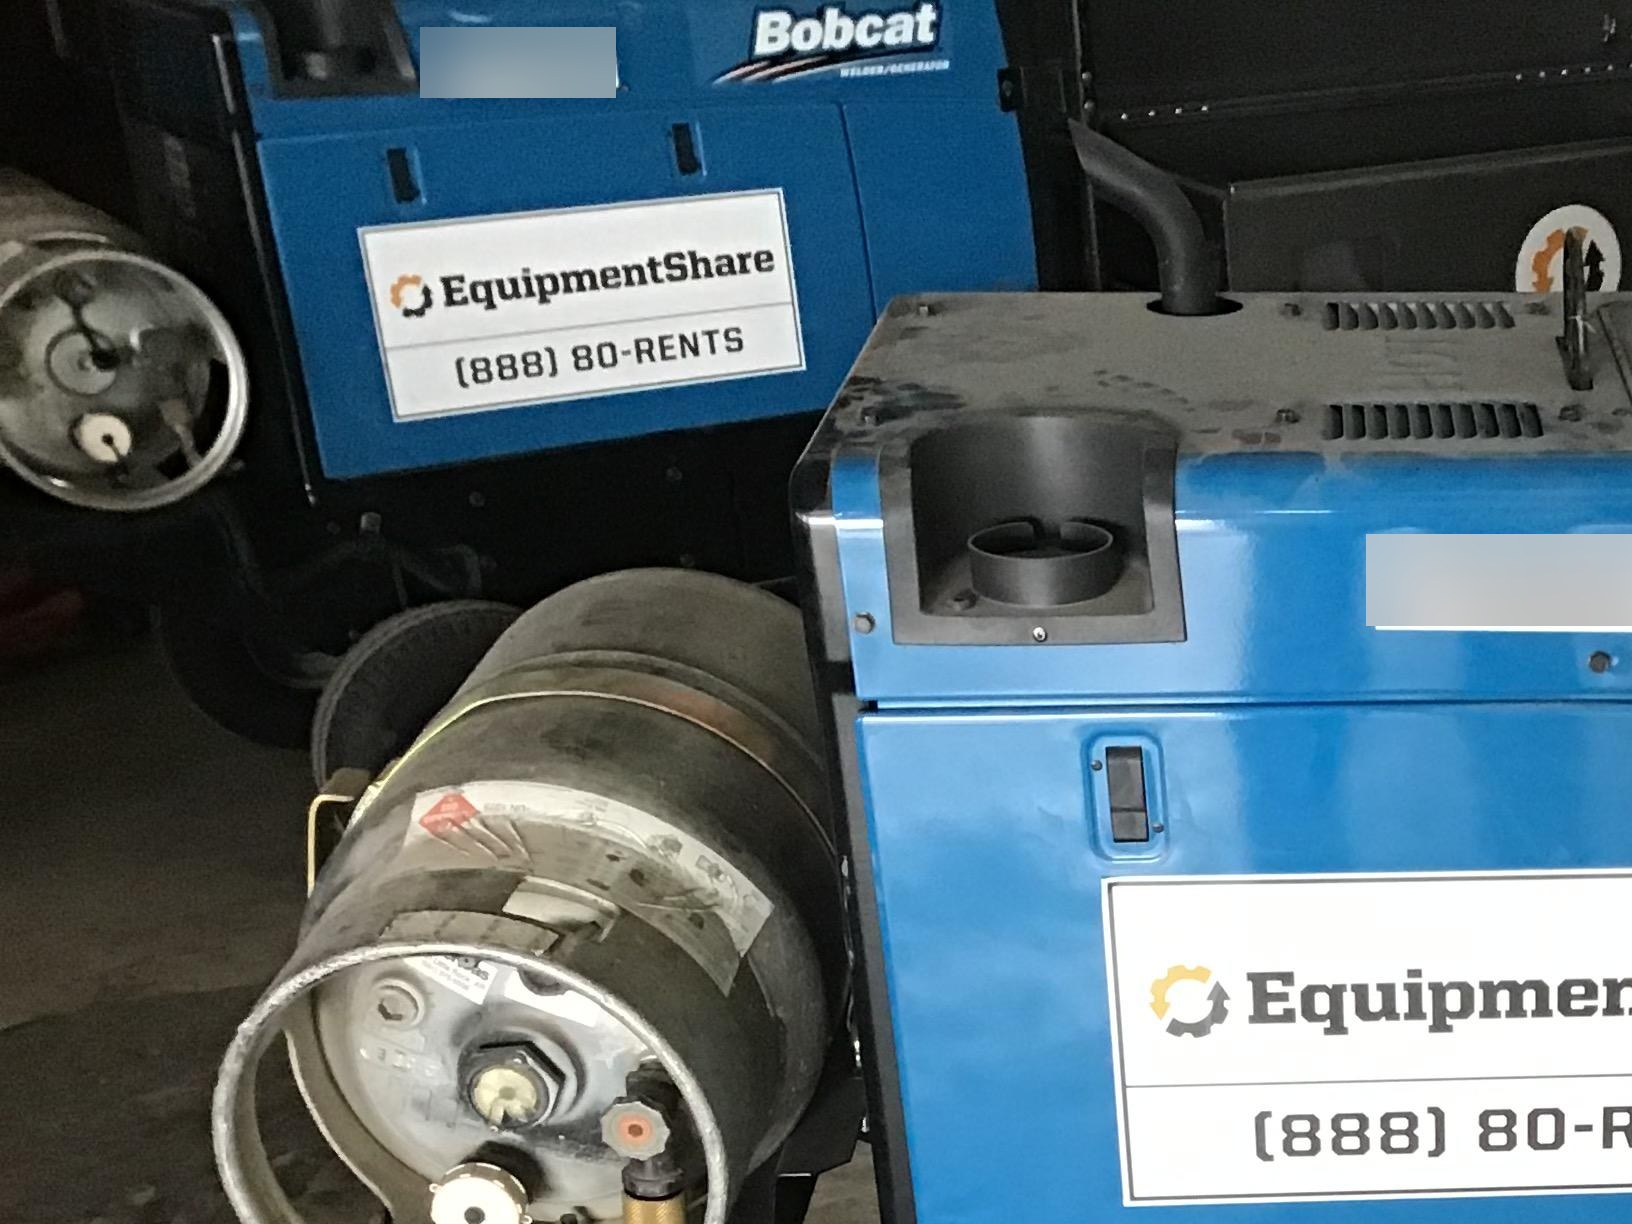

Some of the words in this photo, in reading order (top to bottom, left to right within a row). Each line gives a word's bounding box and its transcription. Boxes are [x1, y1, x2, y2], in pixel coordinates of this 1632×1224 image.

[755, 4, 936, 54] Bobcat
[441, 250, 775, 310] EquipmentShare
[455, 346, 559, 388] (888)
[571, 327, 744, 371] 80-RENTS
[1254, 1107, 1446, 1161] (888)
